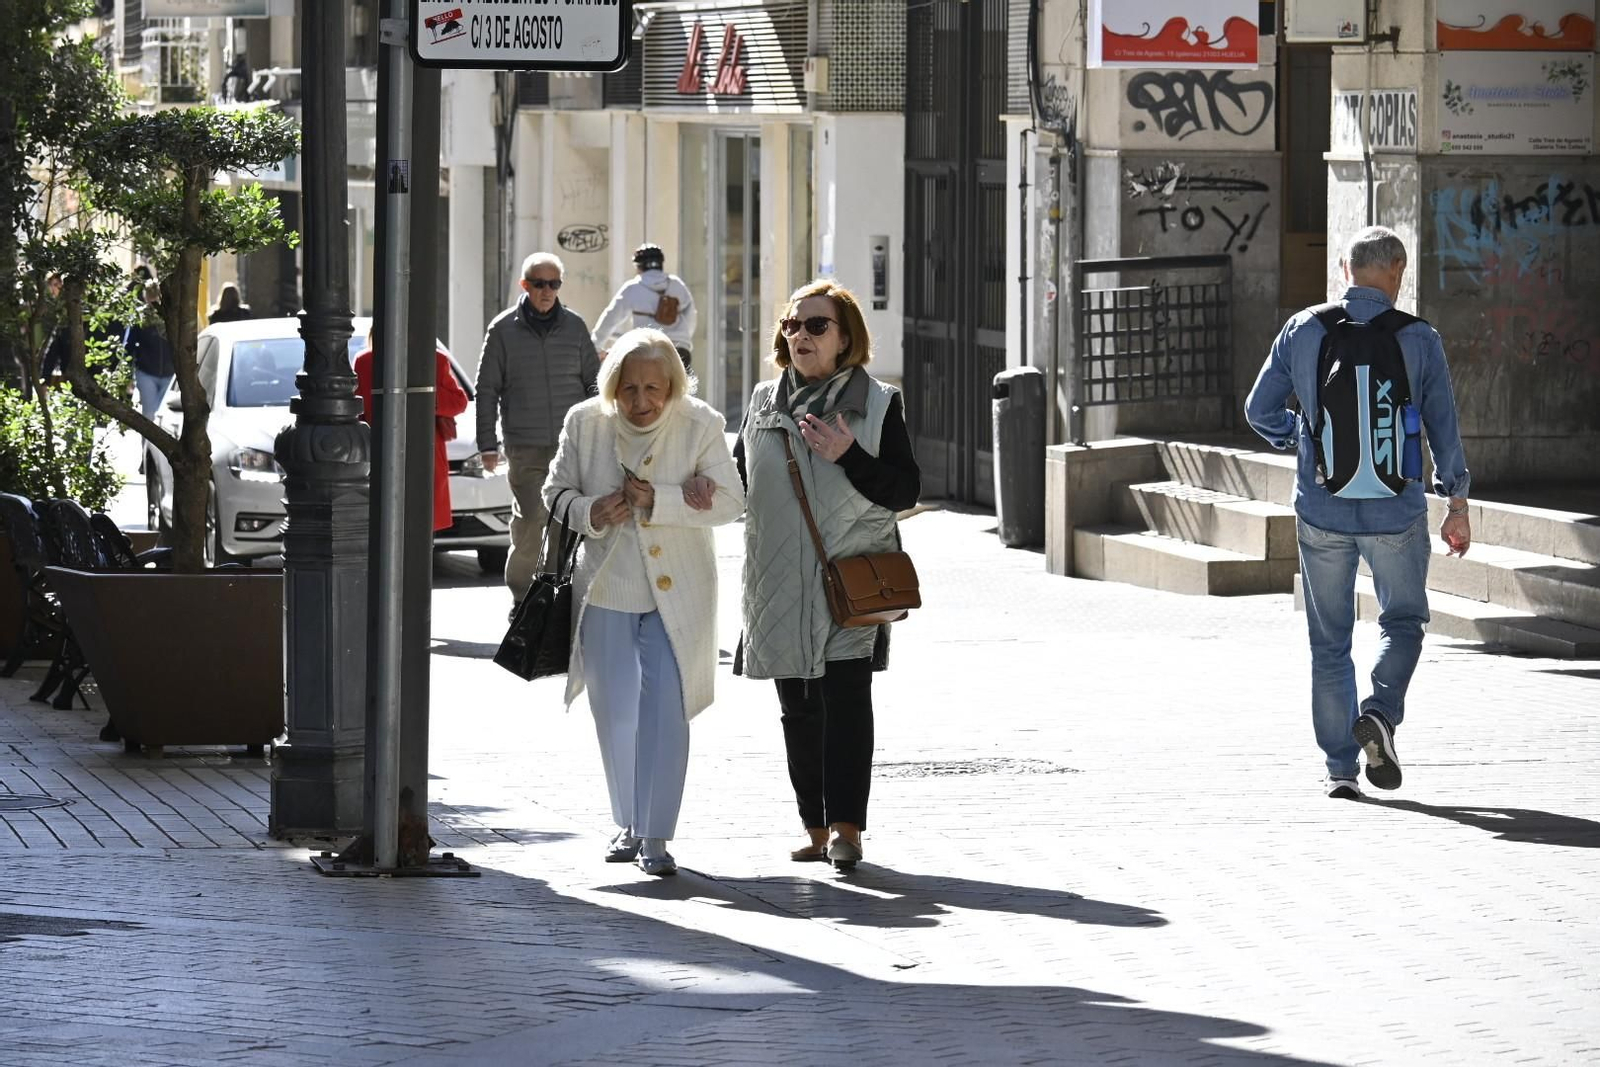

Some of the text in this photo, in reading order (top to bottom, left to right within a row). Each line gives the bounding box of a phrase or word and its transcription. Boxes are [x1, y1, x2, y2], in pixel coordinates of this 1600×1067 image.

[471, 14, 563, 50] C/ 3 DE AGOSTO
[1373, 379, 1393, 476] SIUX
